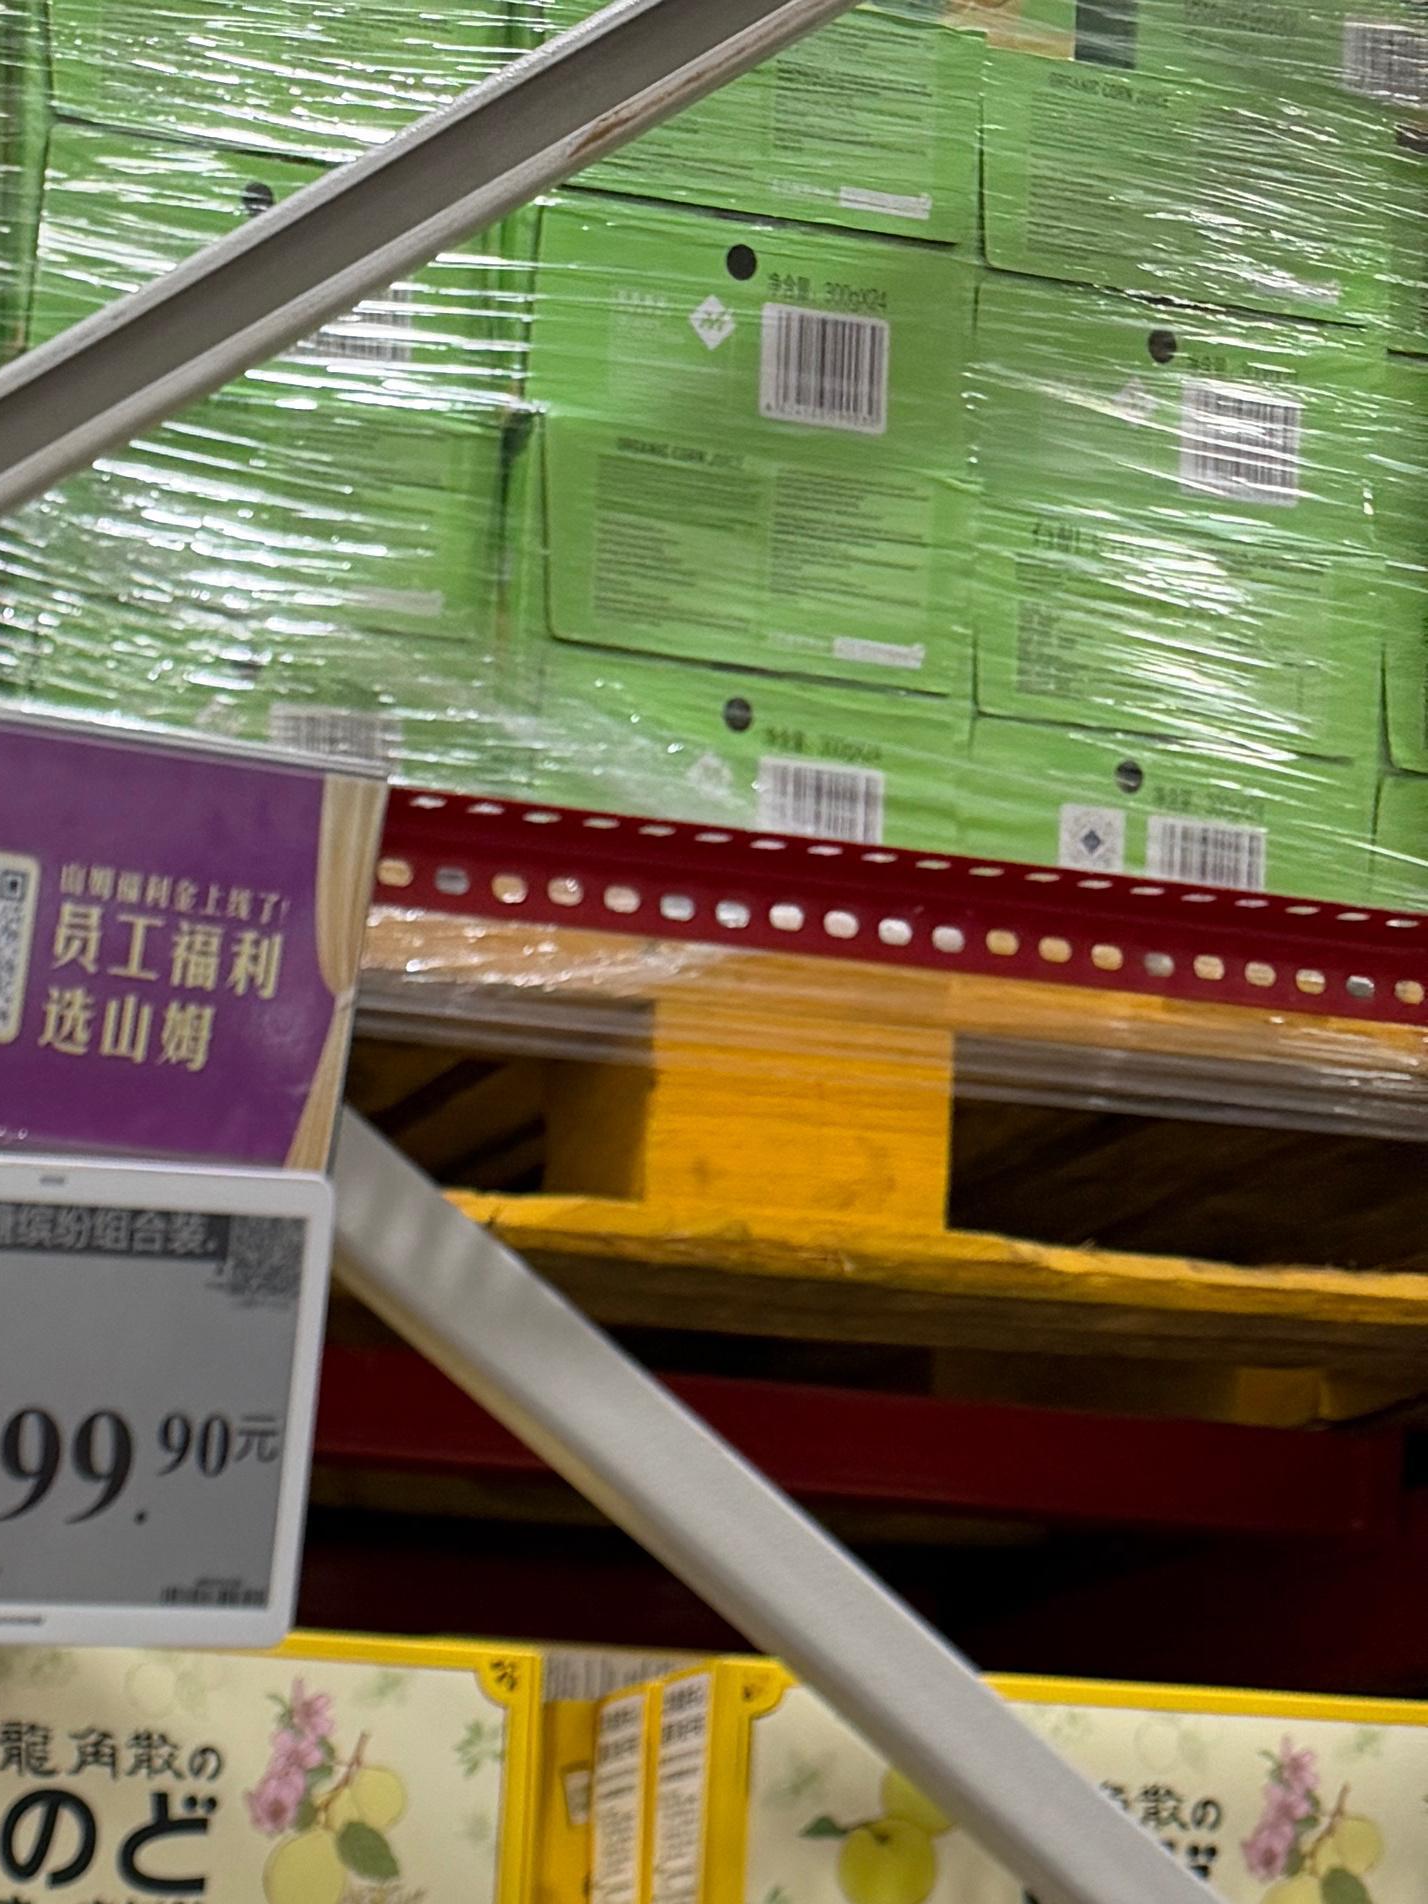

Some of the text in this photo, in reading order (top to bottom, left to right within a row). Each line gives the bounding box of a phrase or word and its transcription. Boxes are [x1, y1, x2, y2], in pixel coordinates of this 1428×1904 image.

[50, 900, 285, 1000] 员工福利
[37, 986, 217, 1073] 选山姆
